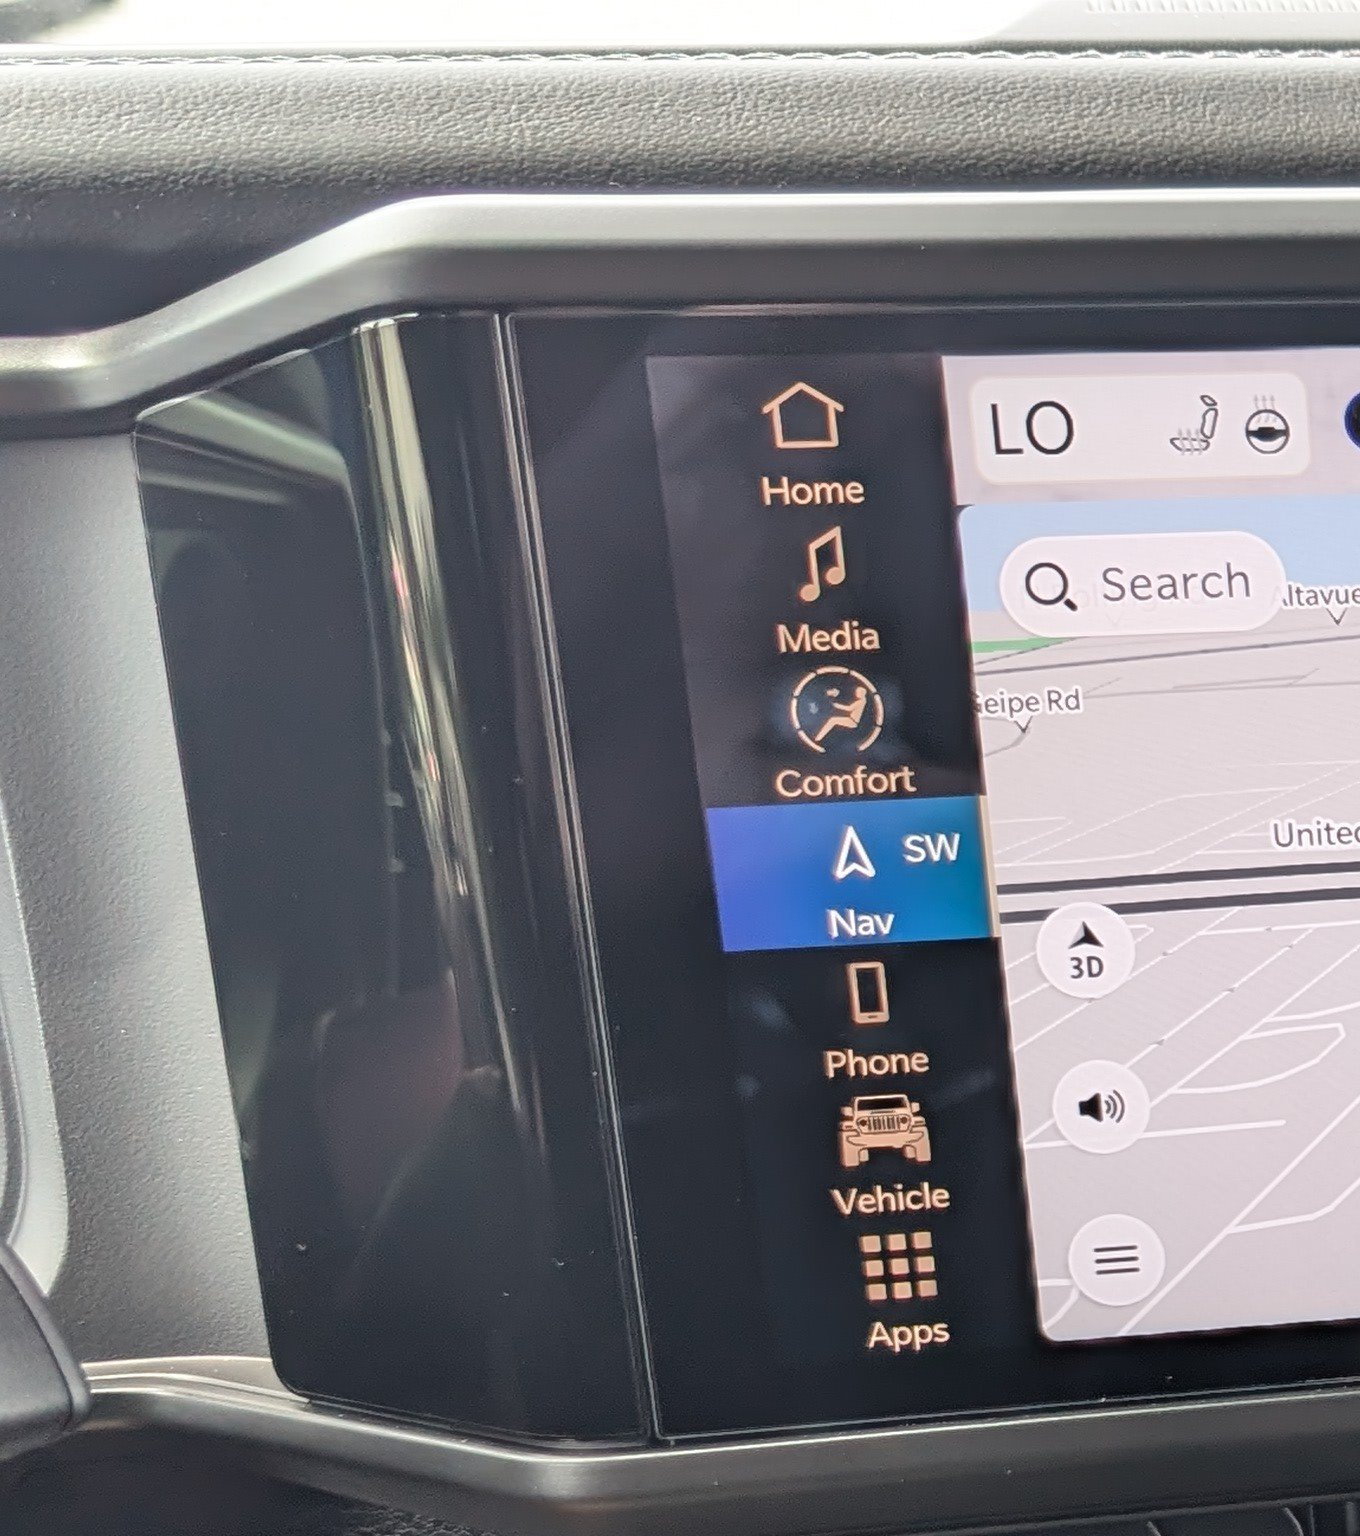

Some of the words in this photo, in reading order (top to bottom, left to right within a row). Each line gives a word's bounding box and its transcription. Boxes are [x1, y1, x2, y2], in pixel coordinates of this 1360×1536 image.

[991, 399, 1074, 455] LO
[762, 476, 865, 506] Home
[1102, 563, 1250, 603] Search
[777, 622, 880, 653] Media
[1047, 688, 1081, 711] Rd
[775, 766, 916, 798] Comfort
[904, 833, 960, 863] SW
[827, 909, 895, 938] Nav
[1069, 956, 1103, 979] 3D
[824, 1048, 930, 1079] Phone
[830, 1182, 950, 1217] Vehicle
[867, 1319, 950, 1354] Apps
